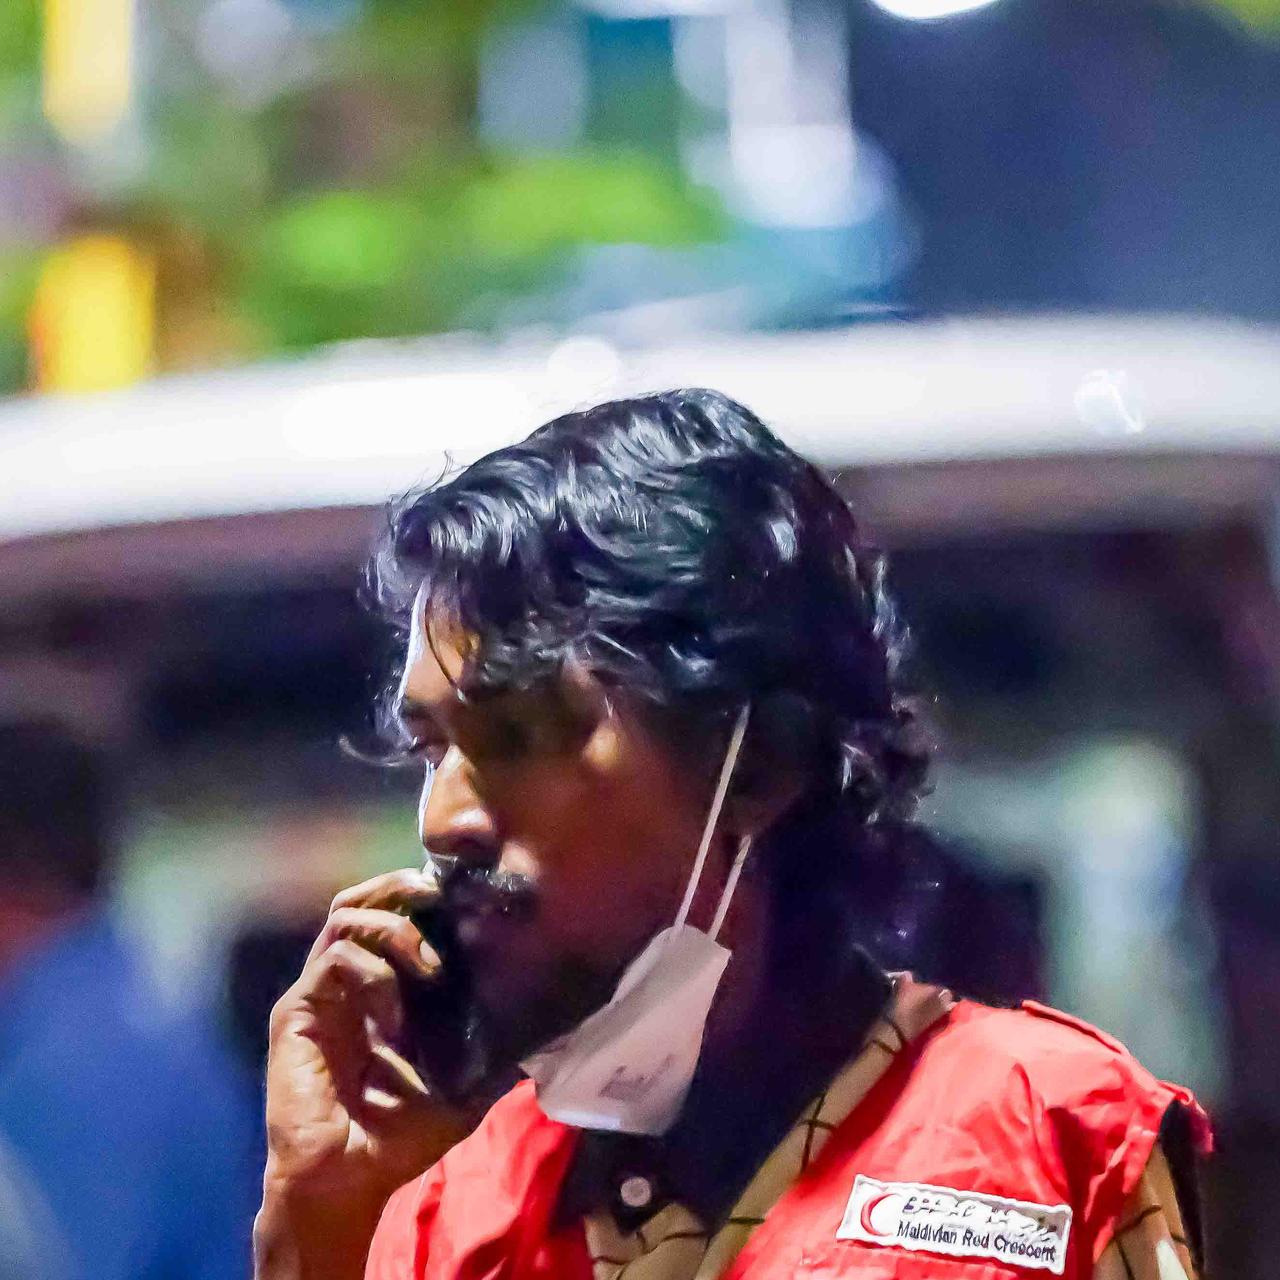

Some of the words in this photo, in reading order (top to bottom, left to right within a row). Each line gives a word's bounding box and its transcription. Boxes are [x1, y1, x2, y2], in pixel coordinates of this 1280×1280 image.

[897, 1220, 957, 1245] Maldivian
[962, 1229, 989, 1249] Red
[994, 1235, 1056, 1262] Crescent
